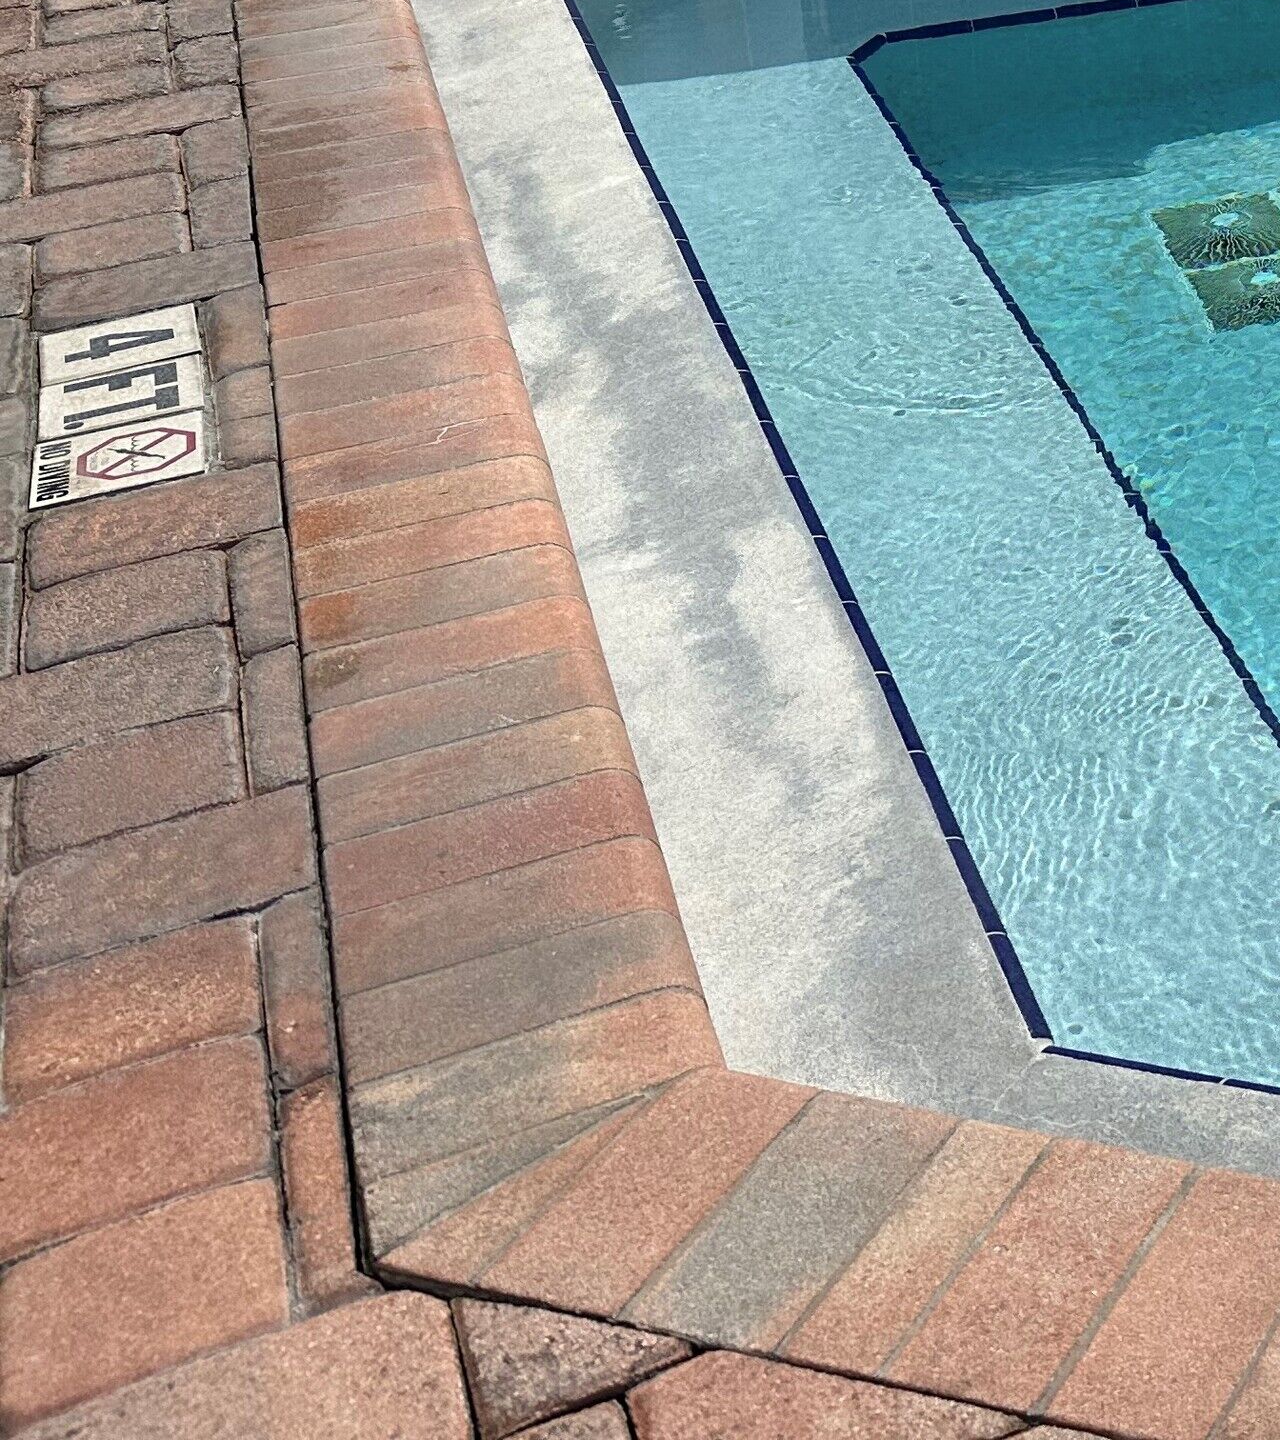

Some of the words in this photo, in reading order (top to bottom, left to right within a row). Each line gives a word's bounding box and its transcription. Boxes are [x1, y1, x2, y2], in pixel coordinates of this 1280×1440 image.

[65, 328, 174, 363] 4
[39, 440, 72, 461] NO
[36, 459, 72, 503] DIVING
